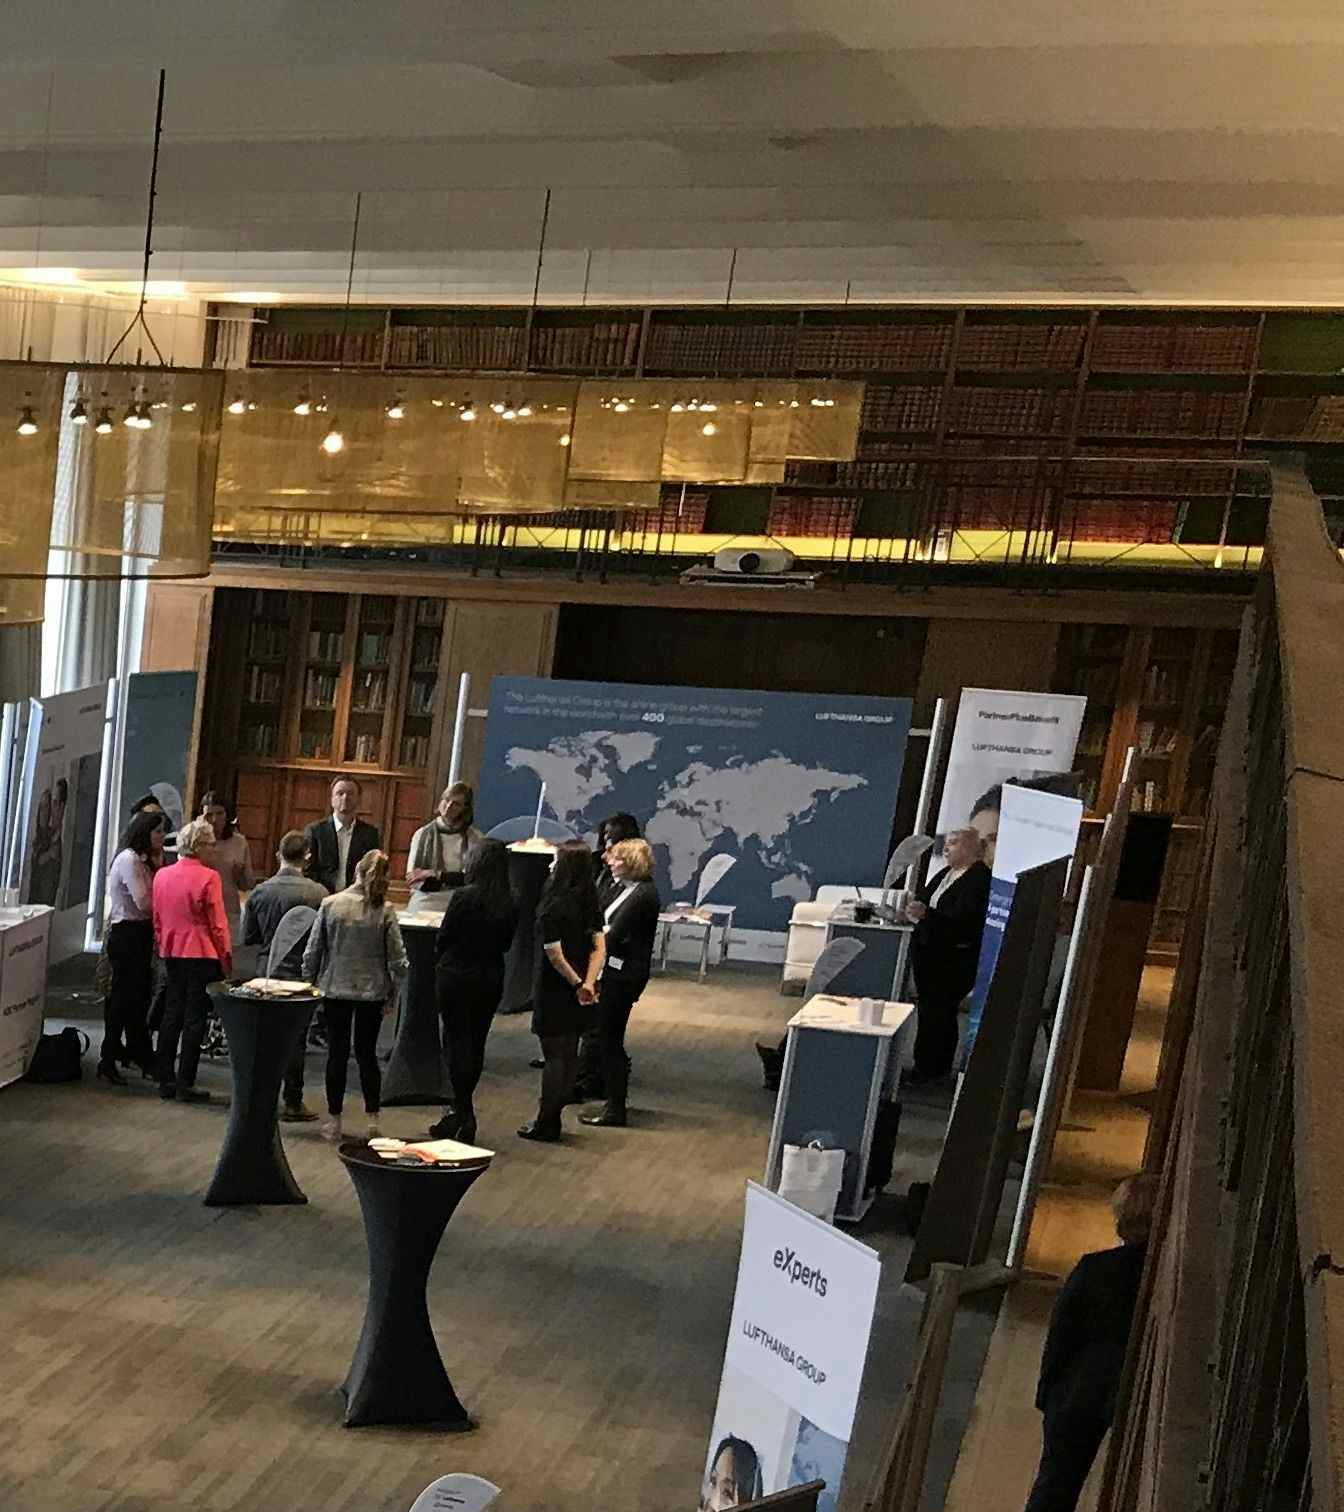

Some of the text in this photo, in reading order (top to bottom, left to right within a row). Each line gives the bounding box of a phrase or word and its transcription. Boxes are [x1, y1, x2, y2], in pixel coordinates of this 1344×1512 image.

[641, 712, 665, 723] 400
[773, 1246, 829, 1298] eXperts
[742, 1319, 827, 1387] LUFTHANSA GROUP
